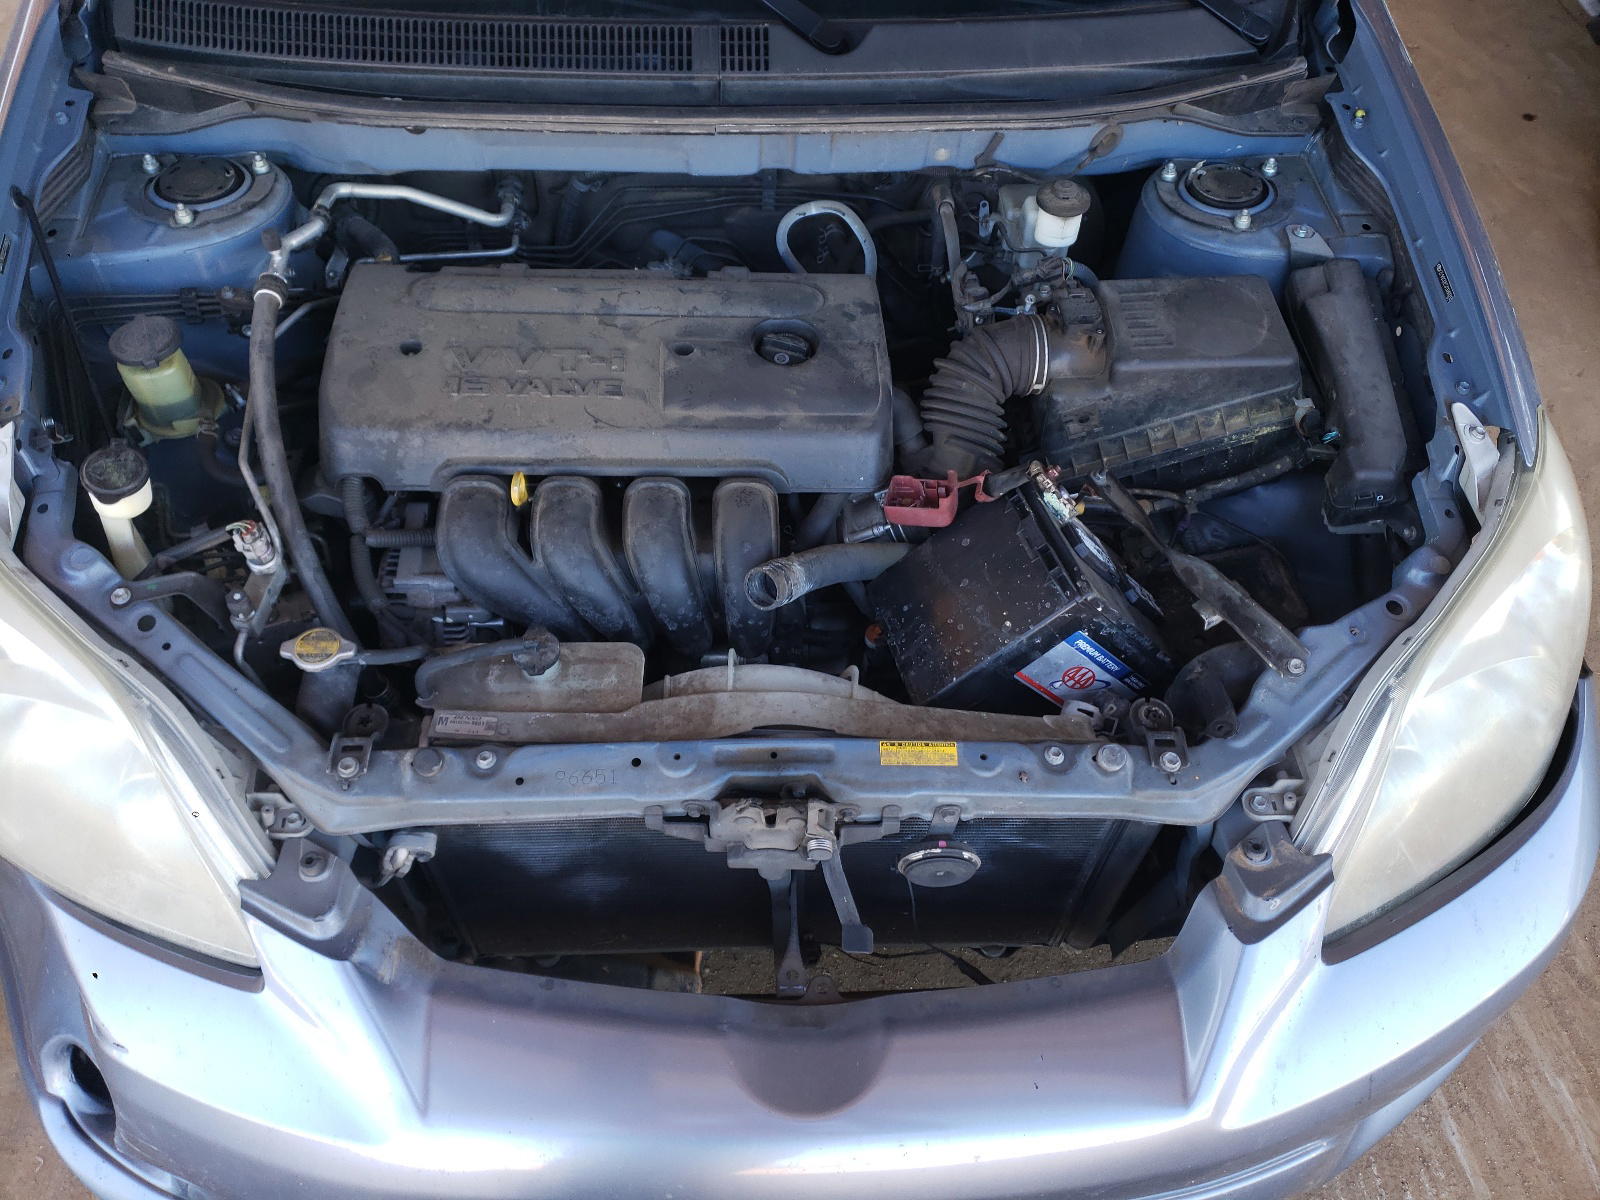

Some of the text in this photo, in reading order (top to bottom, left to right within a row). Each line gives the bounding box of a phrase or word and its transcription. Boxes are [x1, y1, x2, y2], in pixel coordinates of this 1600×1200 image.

[1074, 639, 1120, 672] PREMIUM BATTERY
[1062, 666, 1096, 689] AAA
[555, 768, 617, 785] 96651
